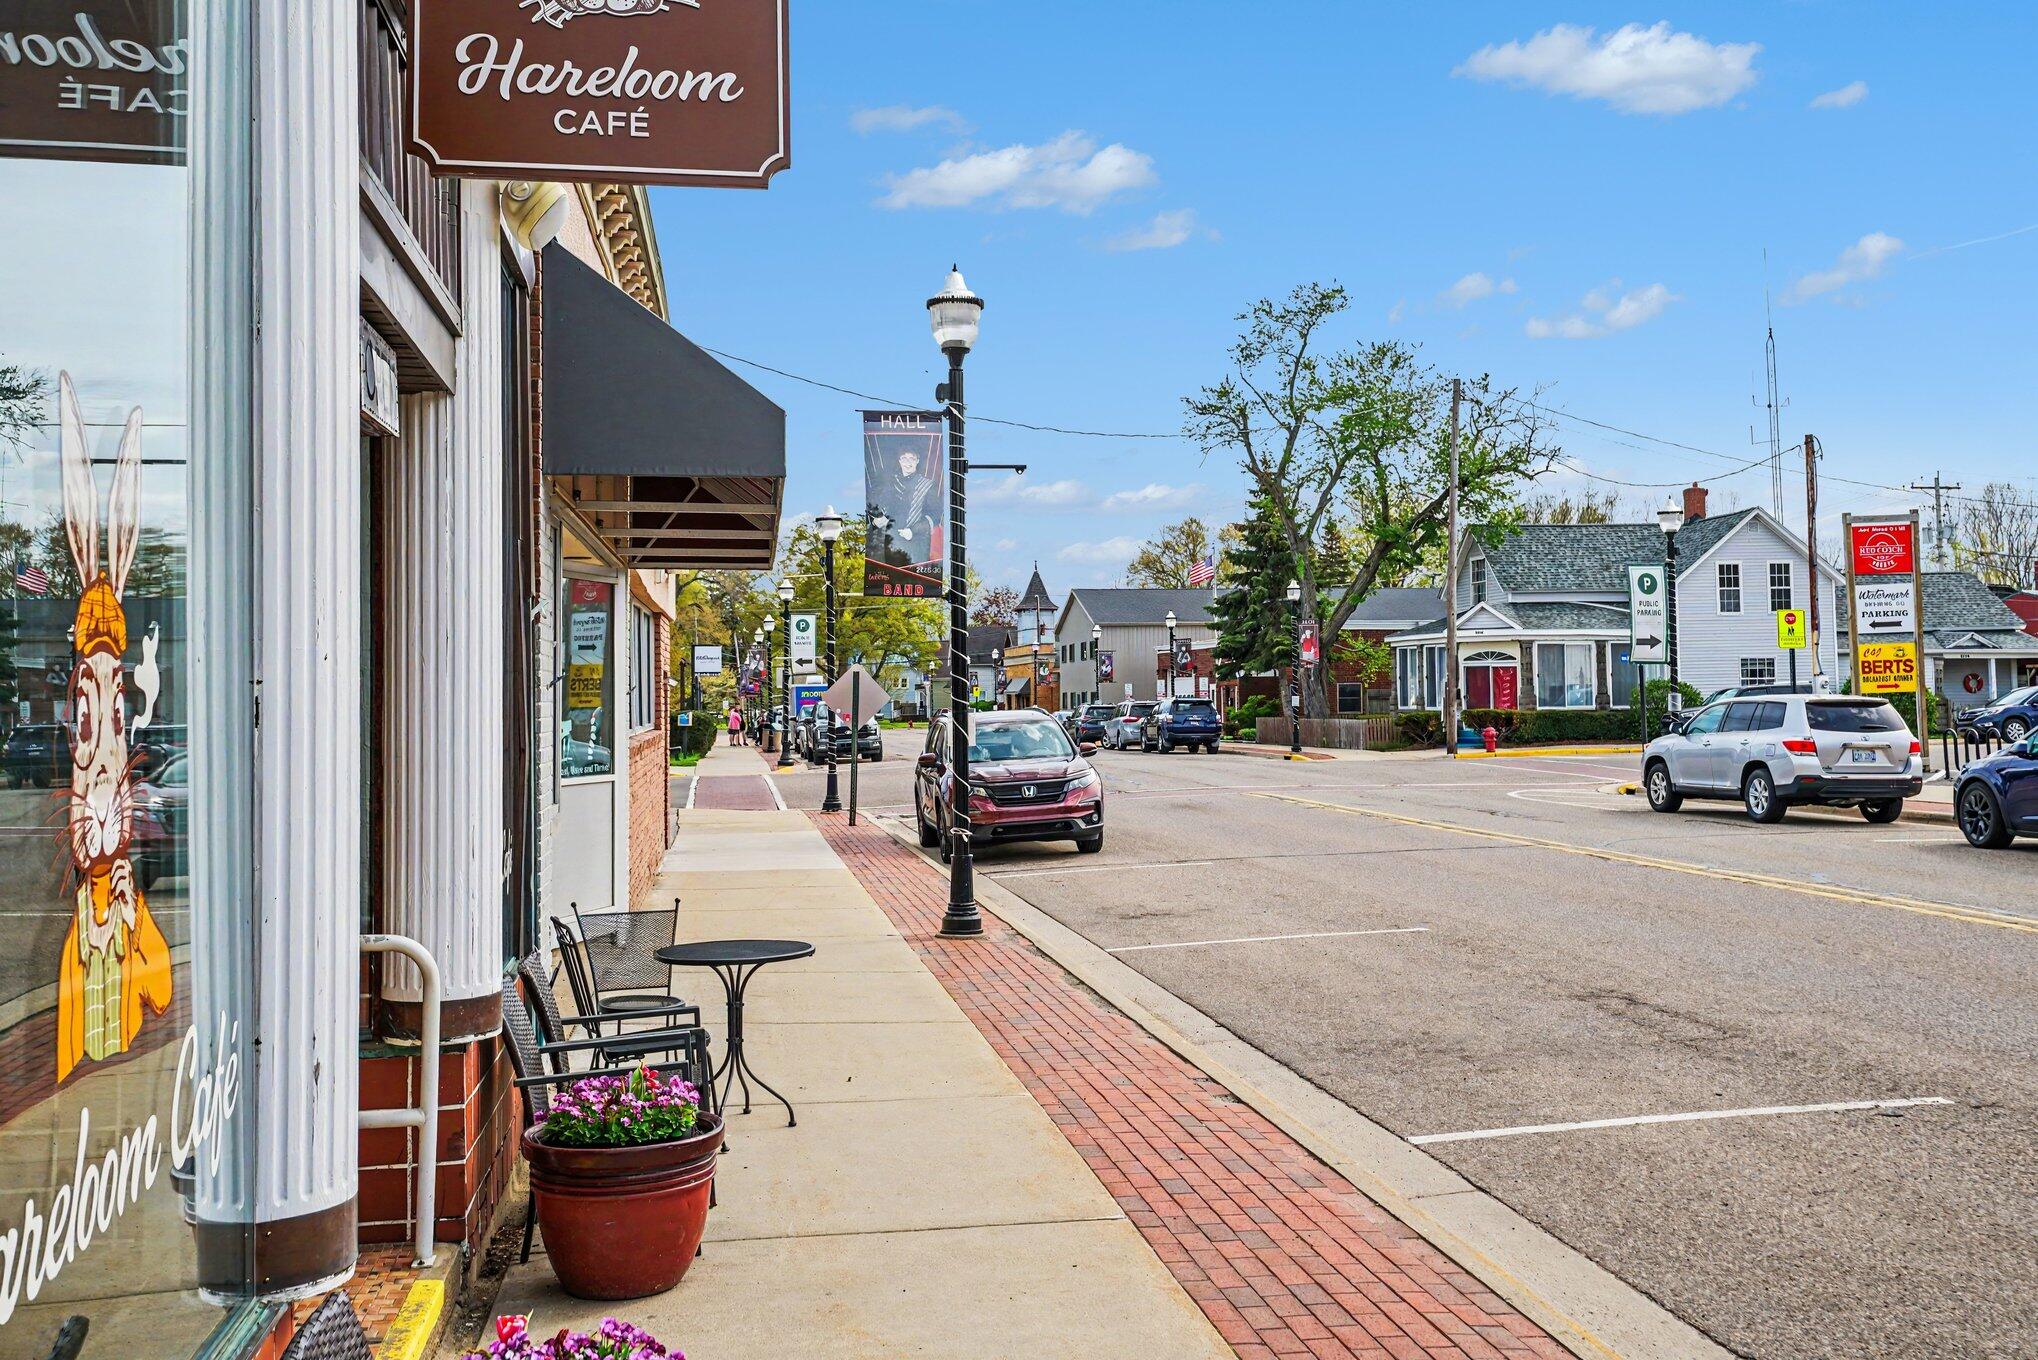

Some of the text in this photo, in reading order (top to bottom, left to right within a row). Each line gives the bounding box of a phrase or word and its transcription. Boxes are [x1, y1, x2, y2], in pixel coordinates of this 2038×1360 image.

[455, 33, 744, 102] Hareloom
[553, 106, 650, 138] CAFÉ
[881, 414, 926, 429] HALL
[883, 583, 924, 596] BAND
[1858, 588, 1910, 601] Watermark
[1638, 600, 1659, 608] PUBLIC
[1636, 609, 1662, 617] PARKING
[1861, 610, 1909, 618] PARKING
[1861, 658, 1915, 674] BERTS
[171, 1009, 239, 1178] Café
